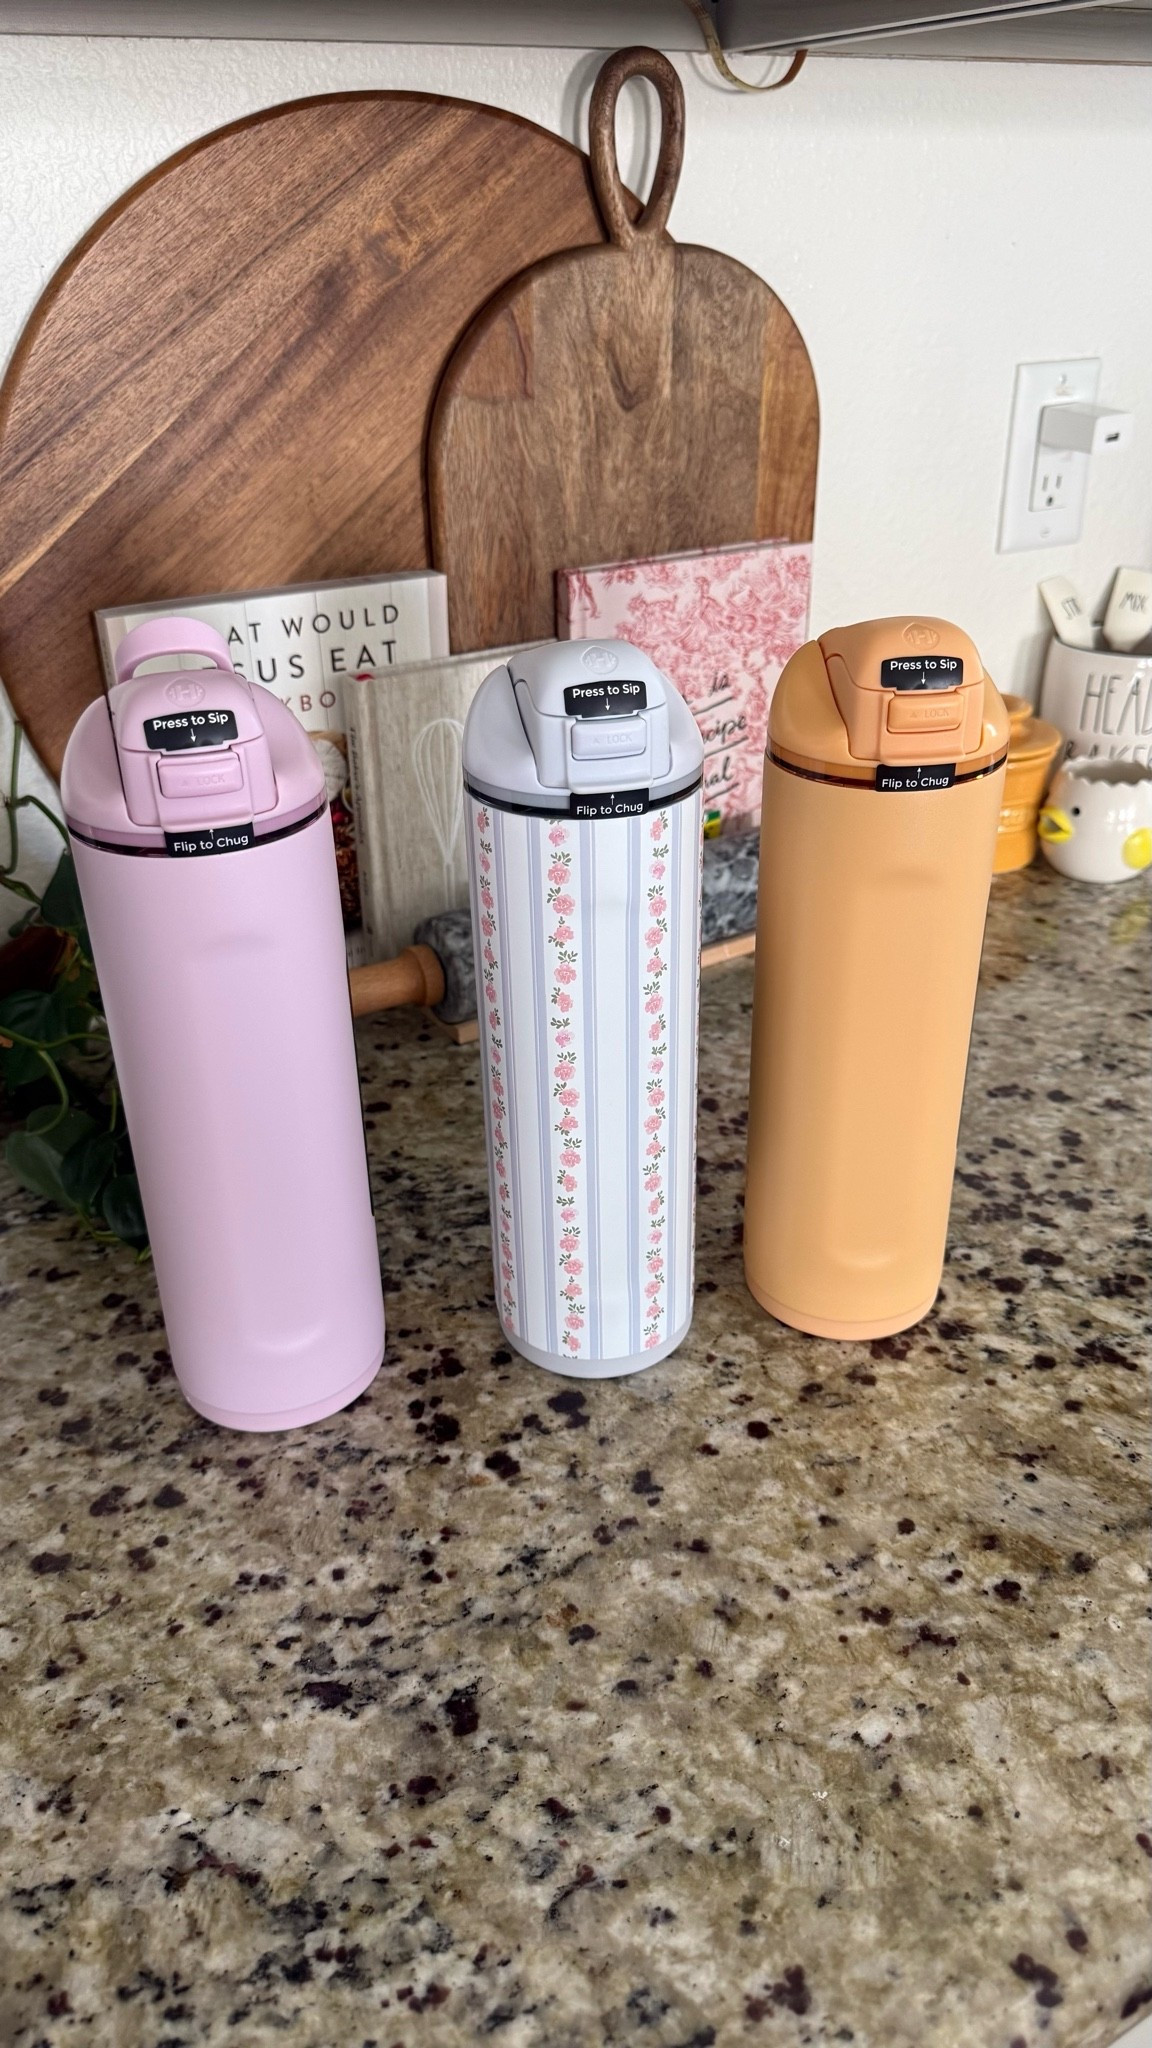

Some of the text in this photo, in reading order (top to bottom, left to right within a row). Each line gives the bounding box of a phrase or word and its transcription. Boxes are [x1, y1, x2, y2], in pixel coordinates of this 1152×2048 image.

[1118, 591, 1149, 613] MIX
[227, 604, 399, 646] AT WOULD
[330, 640, 397, 673] EAT
[890, 658, 958, 671] Press to Sip
[572, 683, 641, 699] Press to Sip
[152, 711, 229, 731] Press to Sip
[924, 708, 950, 719] LOCK
[606, 734, 633, 745] LOCK
[195, 773, 226, 786] LOCK
[881, 776, 949, 790] Flip to Chug
[576, 802, 644, 817] Flip to Chug
[173, 835, 249, 853] Flip to Chug
